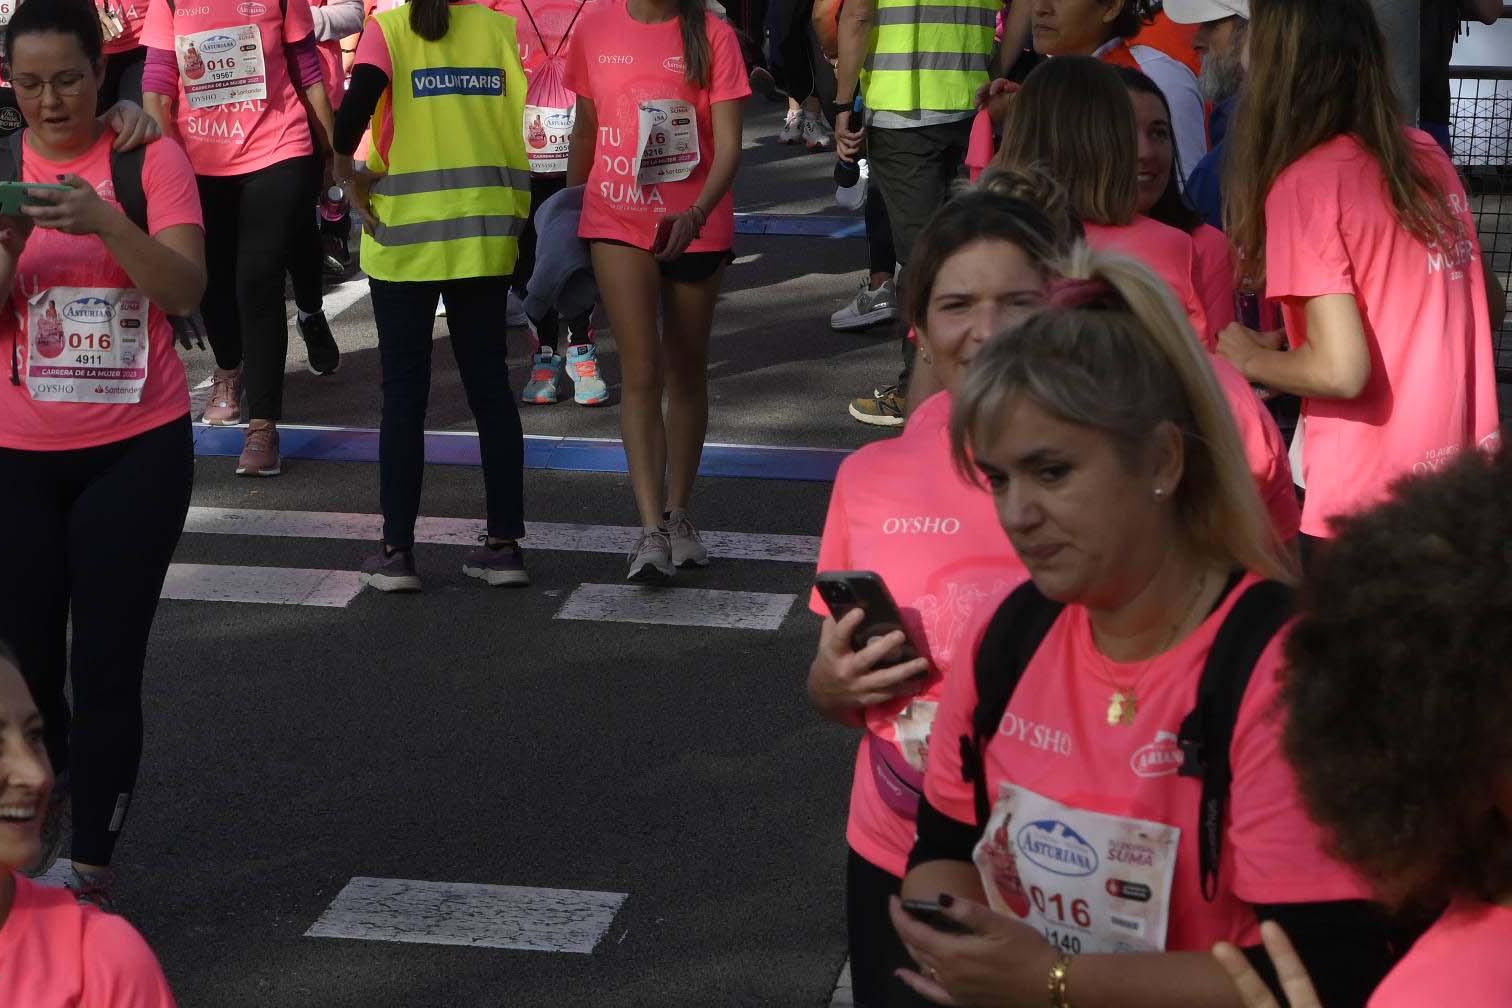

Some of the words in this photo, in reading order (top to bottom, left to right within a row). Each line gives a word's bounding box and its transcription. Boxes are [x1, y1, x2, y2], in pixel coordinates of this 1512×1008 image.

[176, 6, 210, 16] OYSHO
[202, 42, 234, 51] ASTURIANA
[207, 57, 236, 71] 016
[598, 55, 633, 65] OYSHO
[212, 71, 233, 81] 19567
[414, 75, 501, 90] VOLUNTARIS
[191, 93, 217, 103] OYSHO
[188, 117, 245, 138] SUMA
[600, 126, 621, 147] TU
[600, 181, 664, 206] SUMA
[68, 332, 111, 350] 016
[75, 354, 102, 365] 4911
[41, 368, 74, 376] CARRERA
[37, 384, 74, 394] OYSHO
[883, 516, 960, 535] OYSHO
[999, 712, 1073, 758] OYSHO
[1107, 847, 1154, 867] SUMA
[1030, 885, 1091, 928] 016
